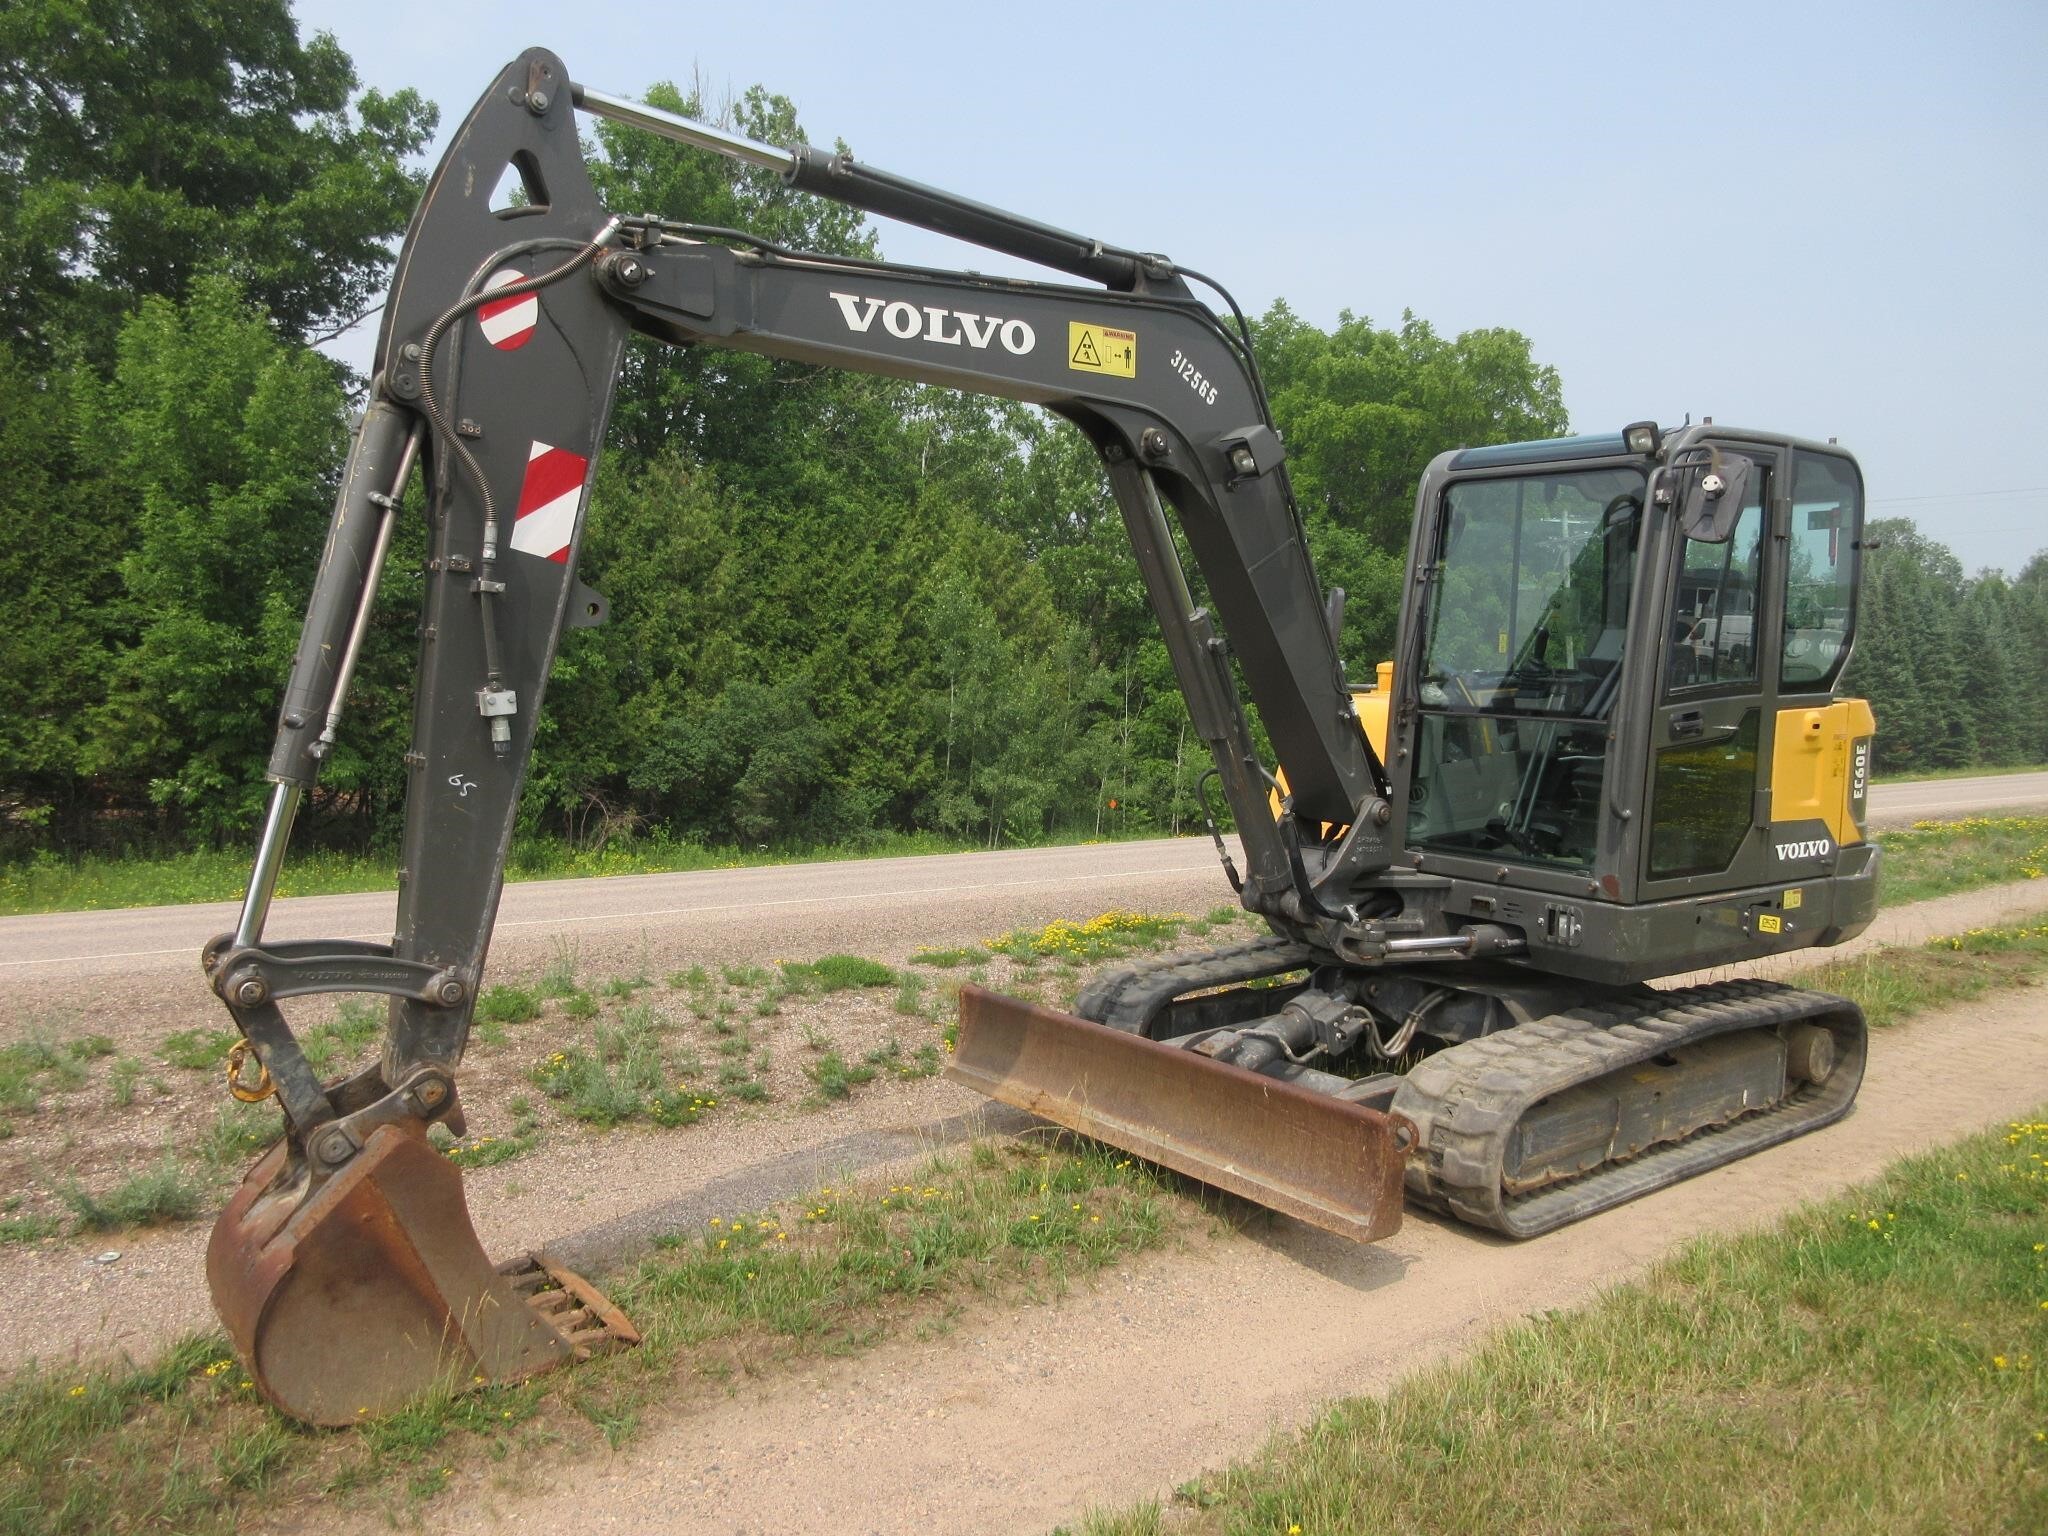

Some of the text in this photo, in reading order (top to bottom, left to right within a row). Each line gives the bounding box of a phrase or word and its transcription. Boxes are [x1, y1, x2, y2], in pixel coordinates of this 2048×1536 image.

[829, 292, 1036, 355] VOLVO
[1108, 331, 1134, 341] WARNING
[1170, 350, 1218, 405] 312565
[1853, 744, 1866, 799] EC60E
[1775, 839, 1830, 861] VOLVO
